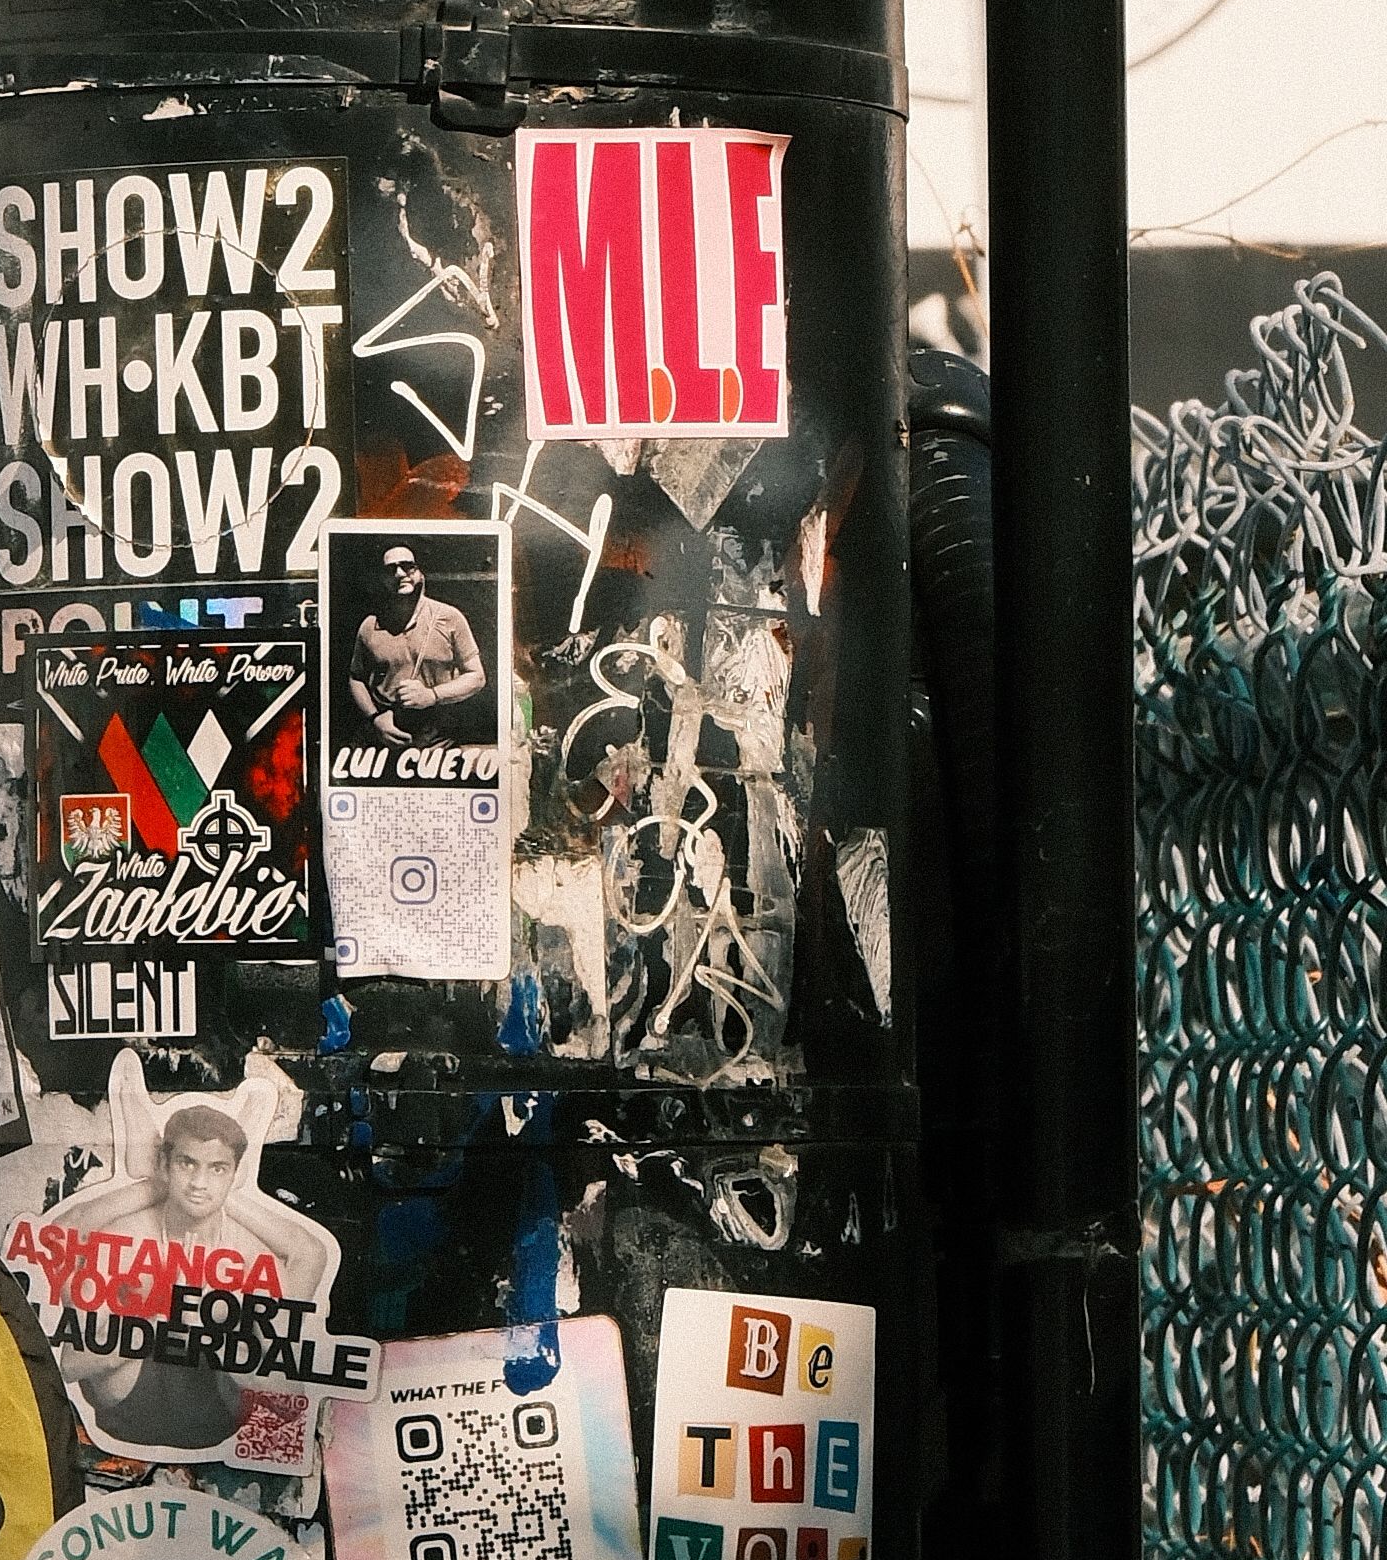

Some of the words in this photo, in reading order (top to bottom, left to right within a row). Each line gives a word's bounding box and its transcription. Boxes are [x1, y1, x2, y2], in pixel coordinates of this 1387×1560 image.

[43, 659, 89, 690] White
[165, 655, 219, 690] White
[226, 654, 296, 691] Power
[331, 746, 390, 779] LUI
[396, 746, 500, 781] CUETO
[115, 849, 167, 881] White
[7, 1220, 283, 1299] ASHTANGA
[38, 1252, 172, 1319] YOGA
[171, 1284, 316, 1344] FORT
[739, 1316, 834, 1389] Be
[390, 1385, 447, 1405] WHAT
[451, 1380, 487, 1398] THE
